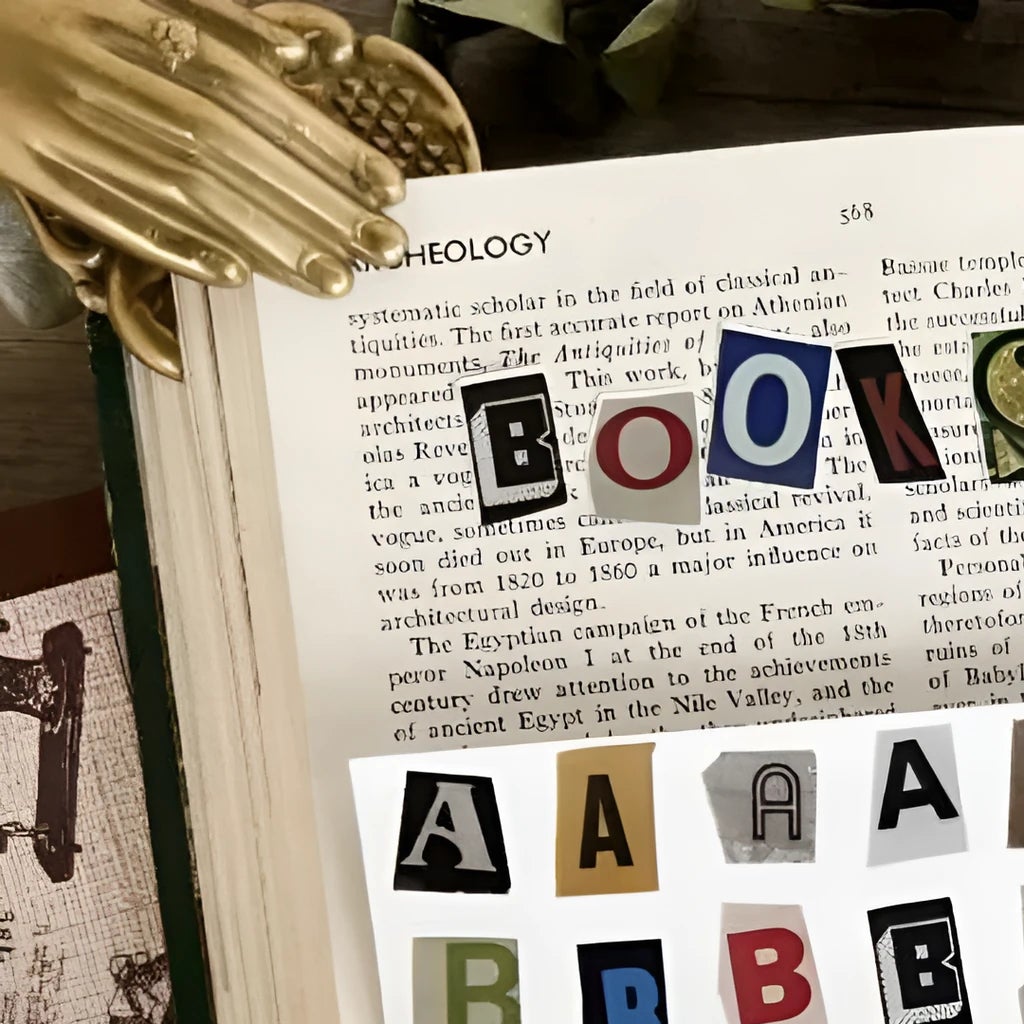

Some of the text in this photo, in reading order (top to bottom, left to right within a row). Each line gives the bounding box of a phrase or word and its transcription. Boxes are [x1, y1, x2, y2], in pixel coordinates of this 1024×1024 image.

[353, 230, 551, 272] HEOLOGY
[402, 783, 497, 870] A
[580, 774, 632, 868] A
[752, 763, 801, 840] A
[879, 739, 959, 830] A
